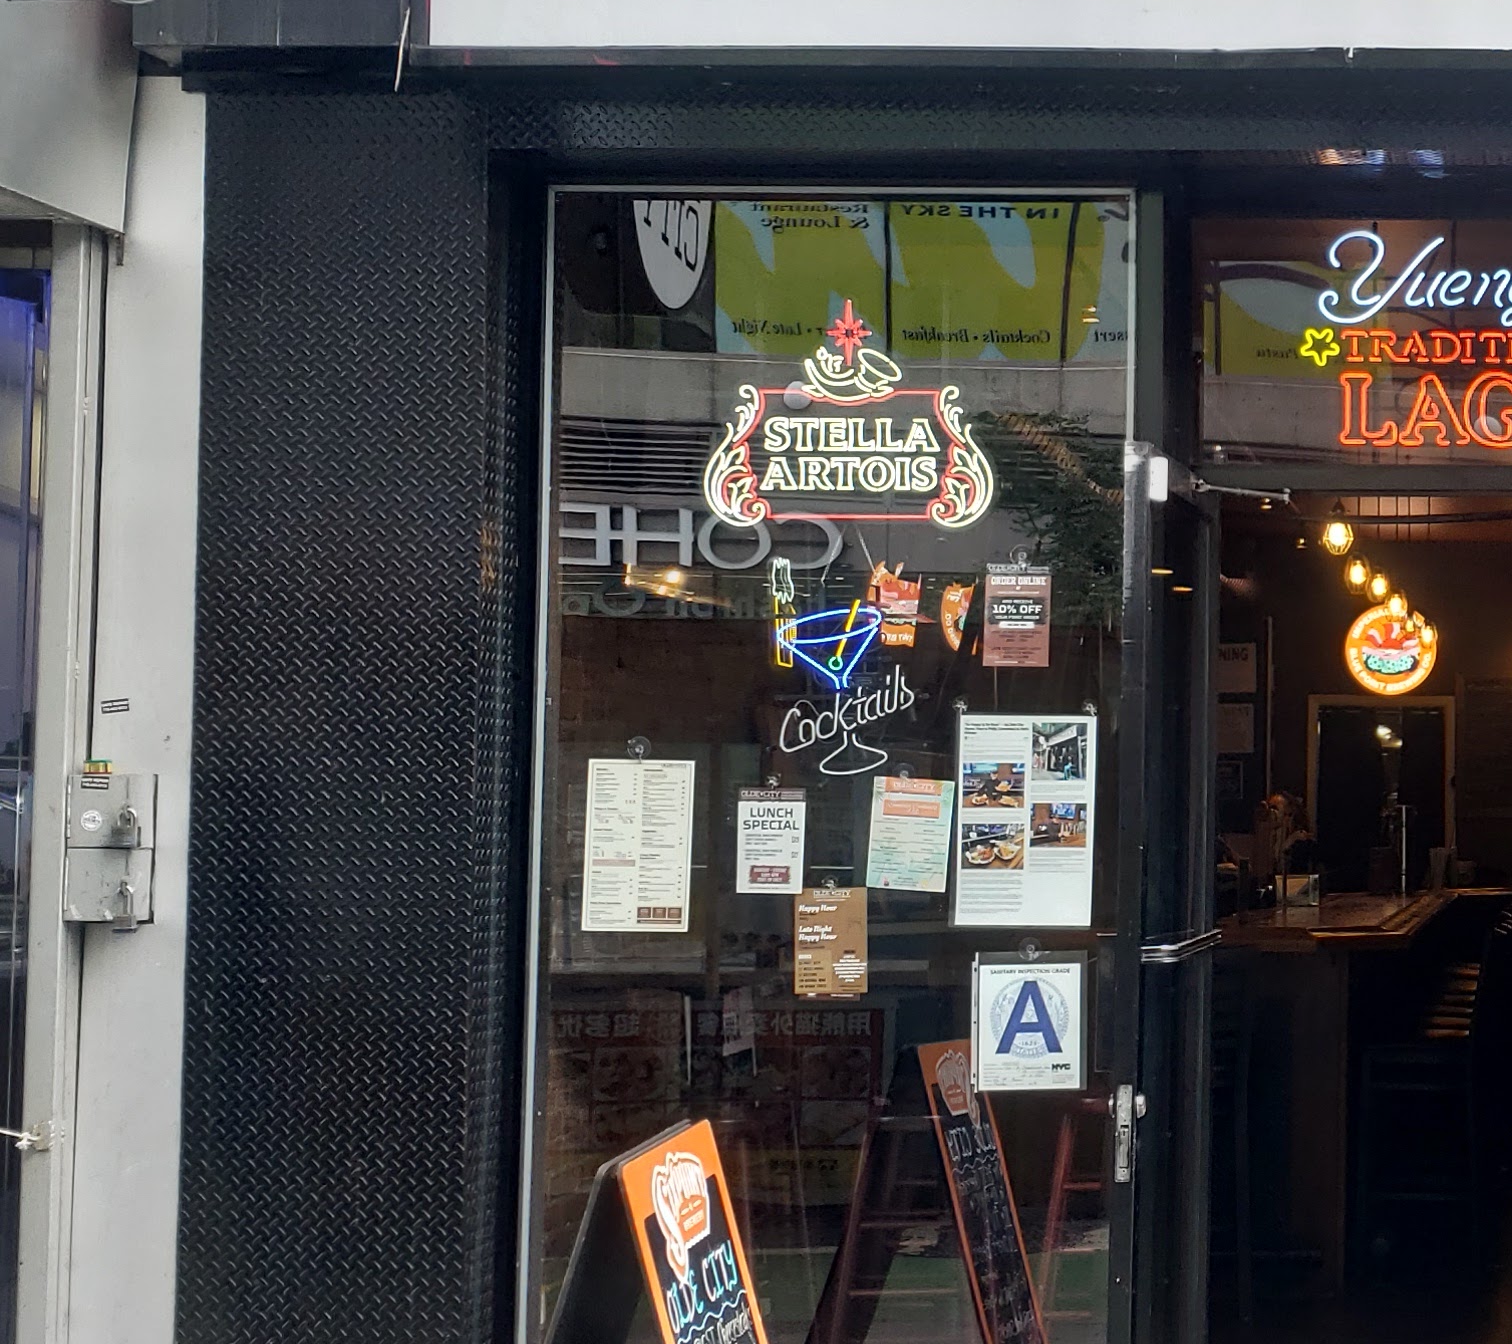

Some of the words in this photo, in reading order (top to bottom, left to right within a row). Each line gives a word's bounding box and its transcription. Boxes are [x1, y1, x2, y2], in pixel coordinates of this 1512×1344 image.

[762, 417, 941, 454] STELLA
[761, 456, 938, 492] ARTOIS
[992, 605, 1017, 614] 10%
[1020, 605, 1043, 614] OFF
[780, 664, 915, 753] Cocktails
[743, 820, 799, 830] SPECIAL
[750, 807, 793, 818] LUNCH
[995, 980, 1063, 1054] A
[667, 1271, 703, 1332] OLDE
[702, 1242, 737, 1301] CITY
